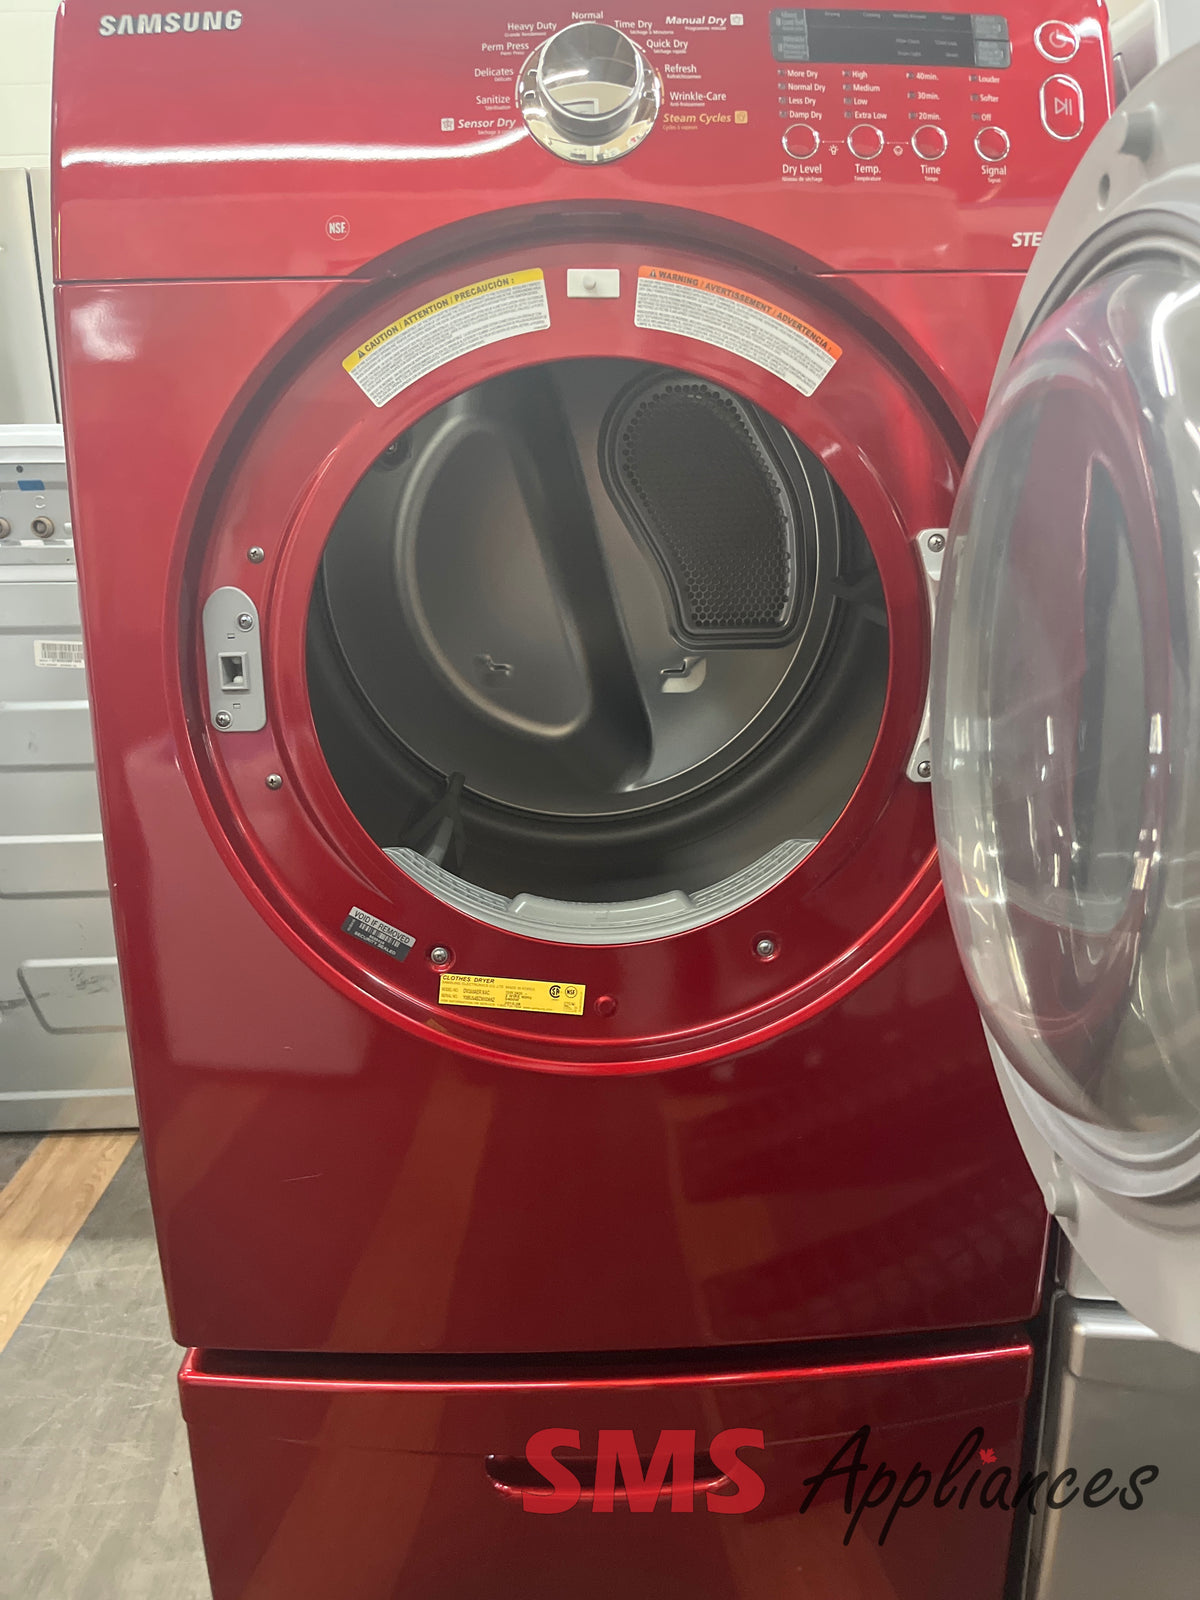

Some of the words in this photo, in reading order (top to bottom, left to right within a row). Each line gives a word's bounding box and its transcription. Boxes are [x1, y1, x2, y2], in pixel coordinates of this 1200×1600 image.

[571, 10, 604, 20] Normal
[98, 9, 243, 37] SAMSUNG
[614, 20, 635, 29] Time
[637, 20, 653, 31] Dry
[665, 16, 705, 25] Manual
[707, 16, 727, 26] Dry
[507, 22, 534, 32] Heavy
[536, 21, 557, 31] Duty
[481, 43, 504, 52] Perm
[506, 42, 529, 50] Press
[646, 39, 671, 48] Quick
[673, 39, 688, 49] Dry
[474, 67, 514, 77] Delicates
[664, 63, 697, 73] Refresh
[787, 69, 805, 78] More
[806, 69, 818, 79] Dry
[852, 70, 868, 80] High
[978, 75, 1000, 84] Louder
[788, 83, 813, 92] Normal
[814, 83, 826, 93] Dry
[853, 84, 880, 92] Medium
[476, 95, 511, 105] Sanitize
[669, 91, 727, 101] Wrinkle-Care
[979, 94, 1000, 103] Softer
[788, 97, 803, 105] Less
[804, 97, 816, 106] Dry
[853, 97, 868, 106] Low
[663, 113, 697, 123] Steam
[699, 112, 732, 125] Cycles
[789, 111, 809, 120] Damp
[810, 111, 822, 120] Dry
[854, 111, 872, 119] Extra
[873, 111, 887, 119] Low
[981, 113, 992, 122] Off
[457, 119, 495, 129] Sensor
[496, 118, 517, 129] Dry
[782, 163, 797, 176] Dry
[799, 163, 822, 174] Level
[854, 163, 882, 176] Temp.
[920, 164, 941, 175] Time
[981, 164, 1007, 178] Signal
[329, 221, 345, 235] NSF
[364, 323, 399, 353] CAUTION
[403, 299, 449, 328] ATTENTION
[454, 275, 510, 302] PRECAUCIÓN
[658, 271, 699, 287] WARNING
[705, 283, 773, 313] AVERTISSEMENT
[776, 312, 828, 348] ADVERTENCIA
[354, 910, 371, 923] VOID
[371, 919, 379, 927] IF
[378, 923, 411, 944] REMOVED
[442, 975, 471, 983] CLOTHES
